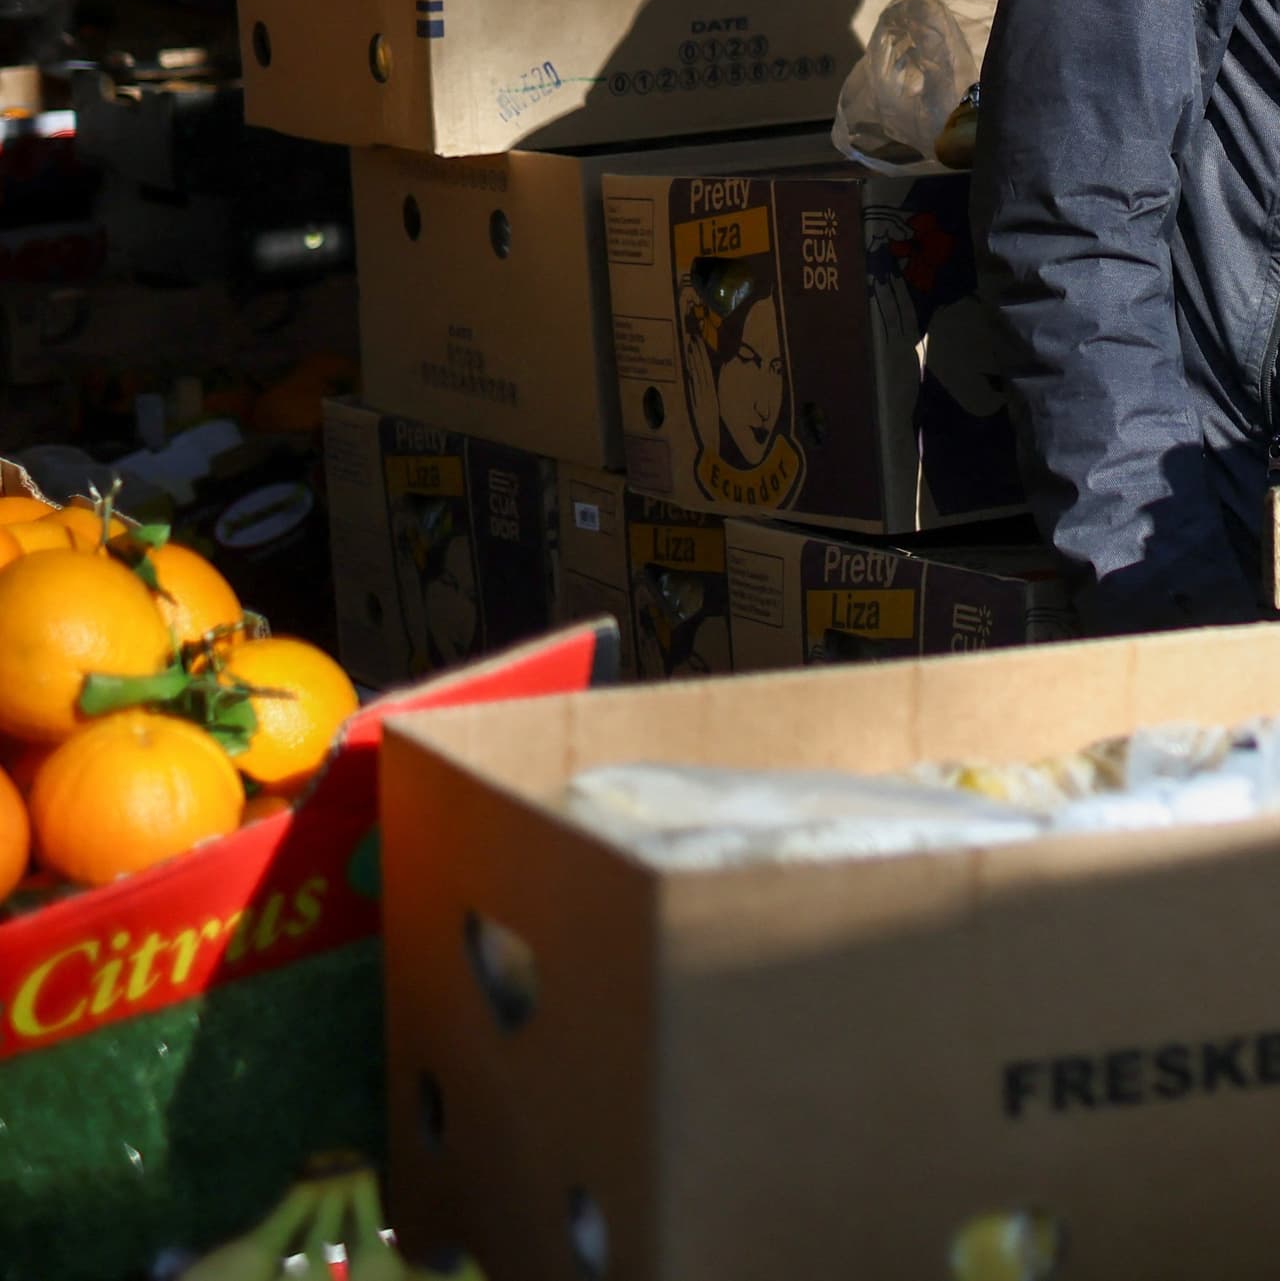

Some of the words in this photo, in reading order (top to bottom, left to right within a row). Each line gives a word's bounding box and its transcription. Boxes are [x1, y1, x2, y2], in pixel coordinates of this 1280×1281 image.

[691, 16, 748, 34] DATE
[690, 179, 752, 215] Pretty
[700, 220, 741, 255] Liza
[802, 238, 838, 263] CUA
[803, 267, 839, 291] DOR
[407, 462, 440, 489] Liza
[710, 459, 792, 505] Ecuador
[653, 527, 696, 563] Liza
[823, 545, 899, 589] Pretty
[831, 592, 880, 631] Liza
[11, 873, 329, 1038] Citrus
